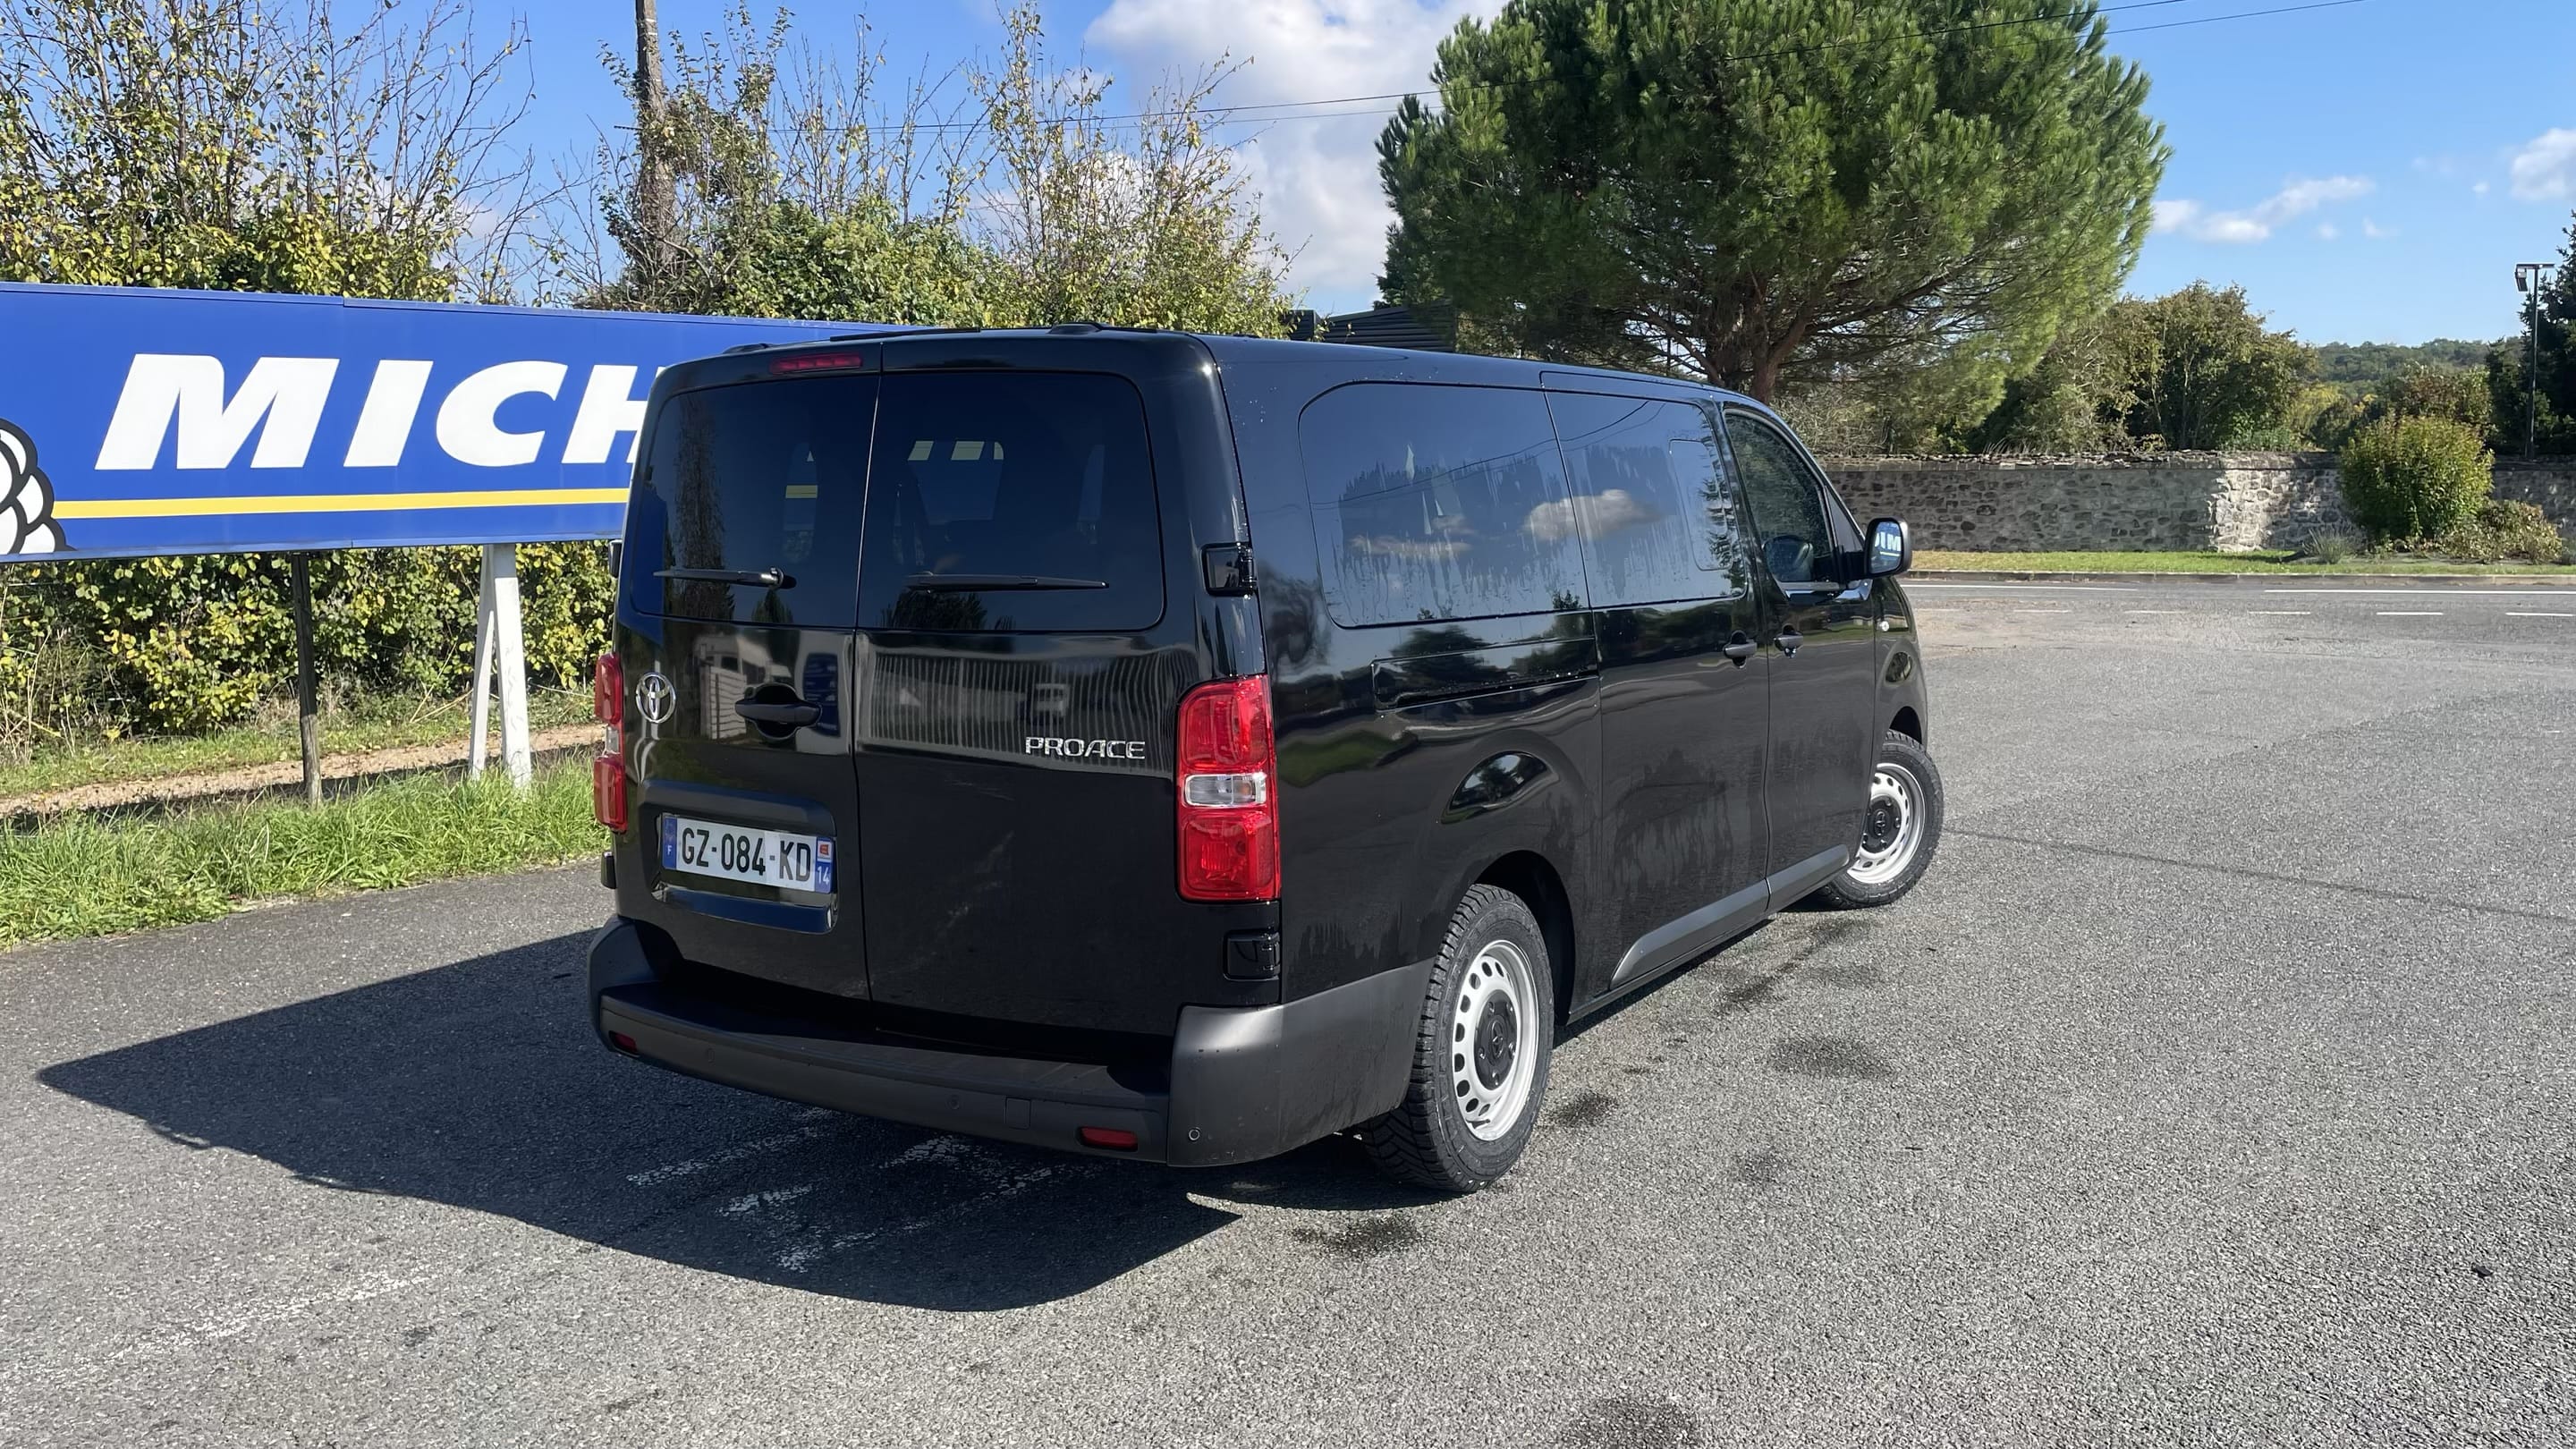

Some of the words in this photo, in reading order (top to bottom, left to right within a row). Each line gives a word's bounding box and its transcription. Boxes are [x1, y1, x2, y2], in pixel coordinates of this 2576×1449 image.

[1025, 736, 1146, 759] PROACE
[667, 845, 672, 855] F
[682, 827, 811, 882] GZ-084-KD
[818, 866, 830, 885] 14
